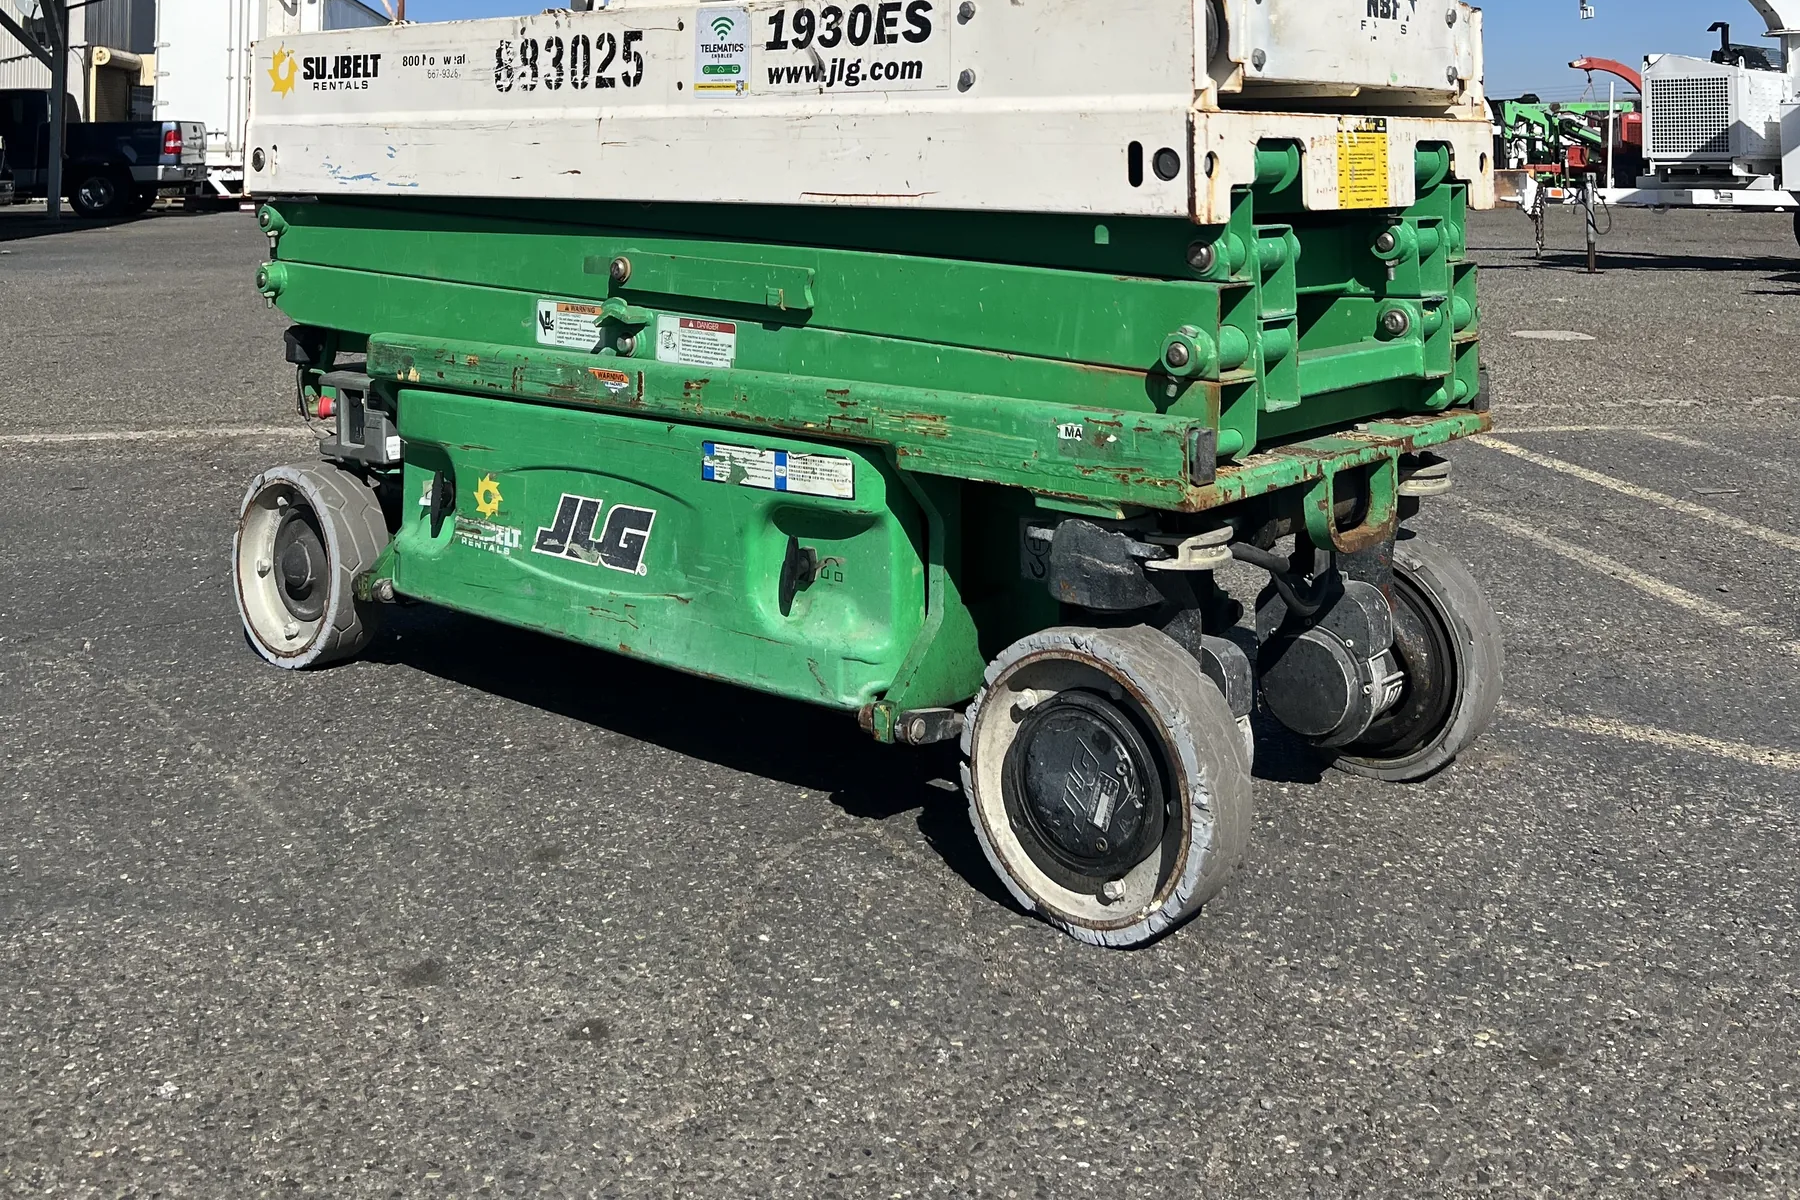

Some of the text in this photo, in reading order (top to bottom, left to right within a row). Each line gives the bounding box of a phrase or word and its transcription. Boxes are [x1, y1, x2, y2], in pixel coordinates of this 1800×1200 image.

[765, 0, 933, 50] 1930ES
[700, 43, 744, 53] TELEMATICS
[767, 58, 923, 87] www.jlg.com
[312, 80, 369, 91] RENTALS
[570, 305, 596, 314] WARNING
[696, 320, 720, 331] DANGER
[597, 371, 624, 382] WARNING
[531, 493, 656, 576] JLG
[461, 536, 510, 556] RENTALS
